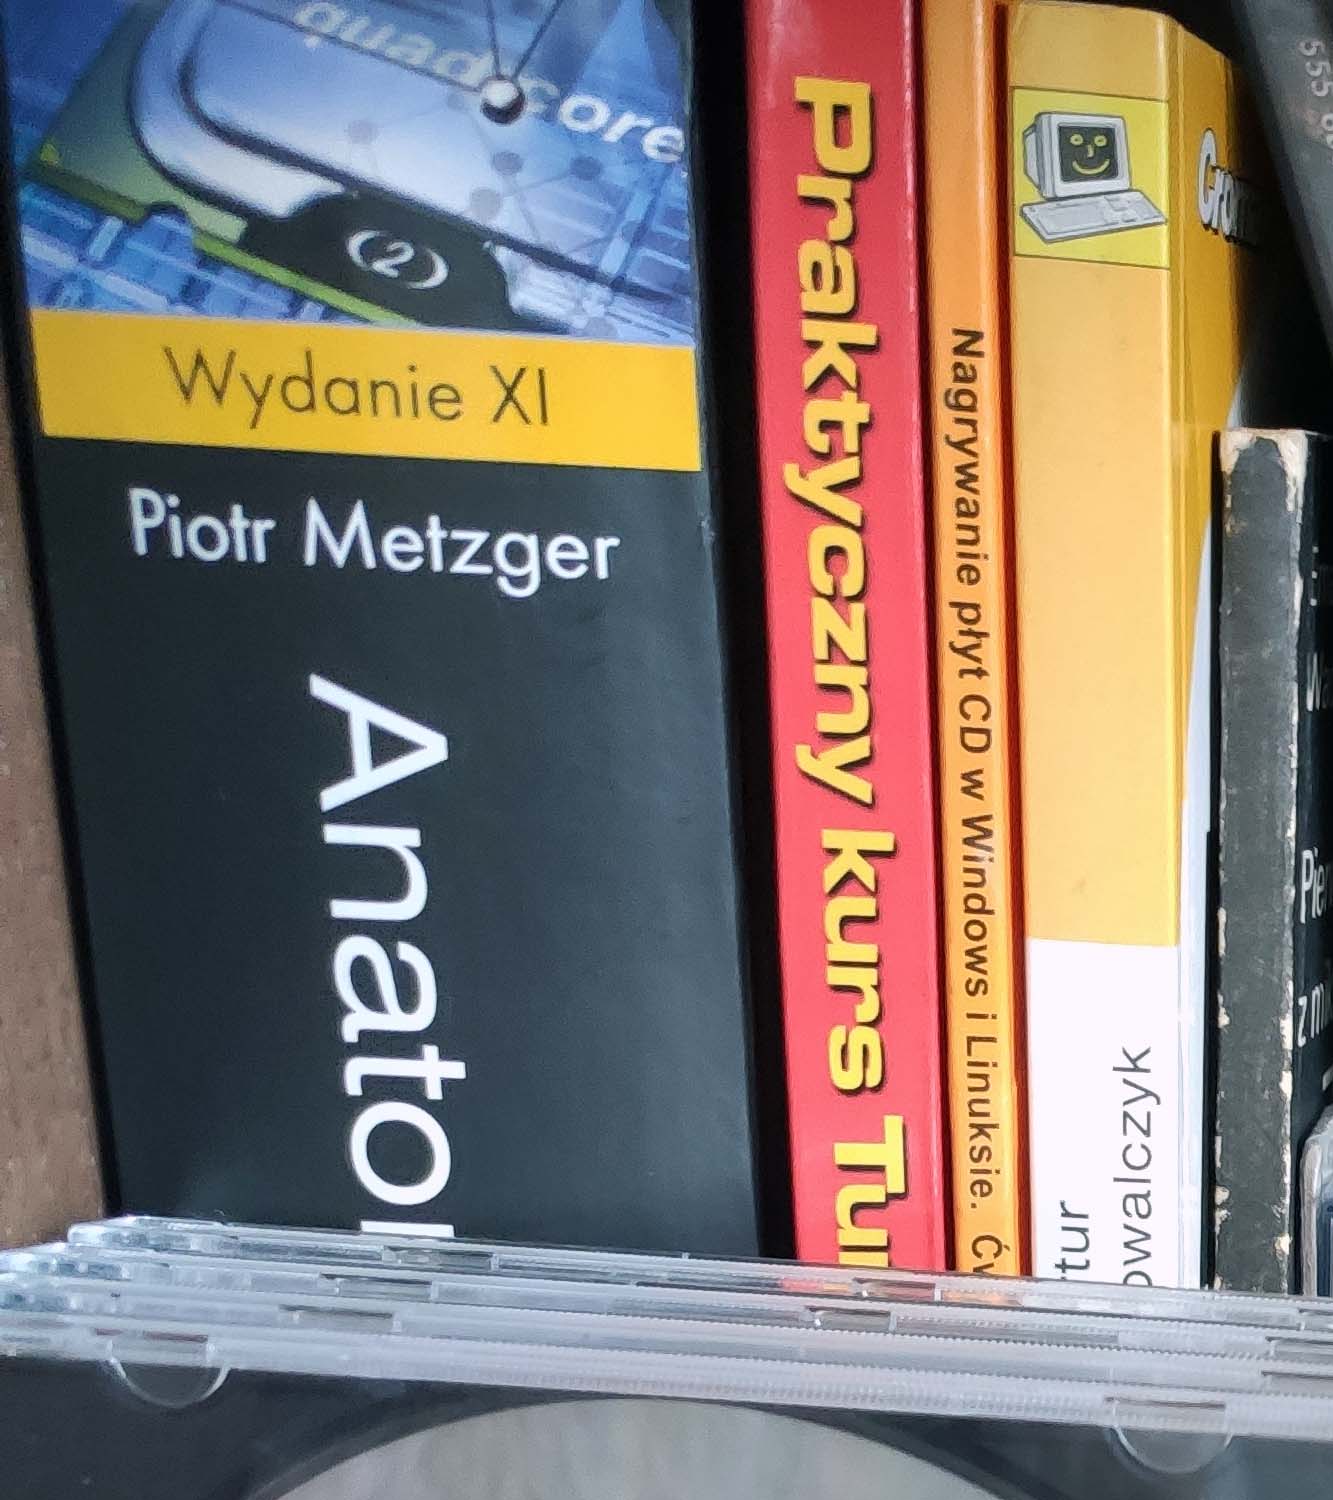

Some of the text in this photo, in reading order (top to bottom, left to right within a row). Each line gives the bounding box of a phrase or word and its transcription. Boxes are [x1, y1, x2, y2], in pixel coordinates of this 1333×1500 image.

[162, 346, 551, 430] Wydanie XI
[783, 76, 880, 808] Praktyczny
[944, 328, 988, 586] Nagrywanie
[127, 486, 622, 597] Piotr Metzger
[949, 602, 987, 681] płyt
[958, 694, 994, 753] CD
[960, 769, 985, 801] w
[961, 814, 996, 999] Windows
[821, 828, 896, 1093] kurs
[966, 1011, 998, 1022] i
[966, 1033, 998, 1211] Linuksie.
[1054, 1201, 1090, 1280] tur
